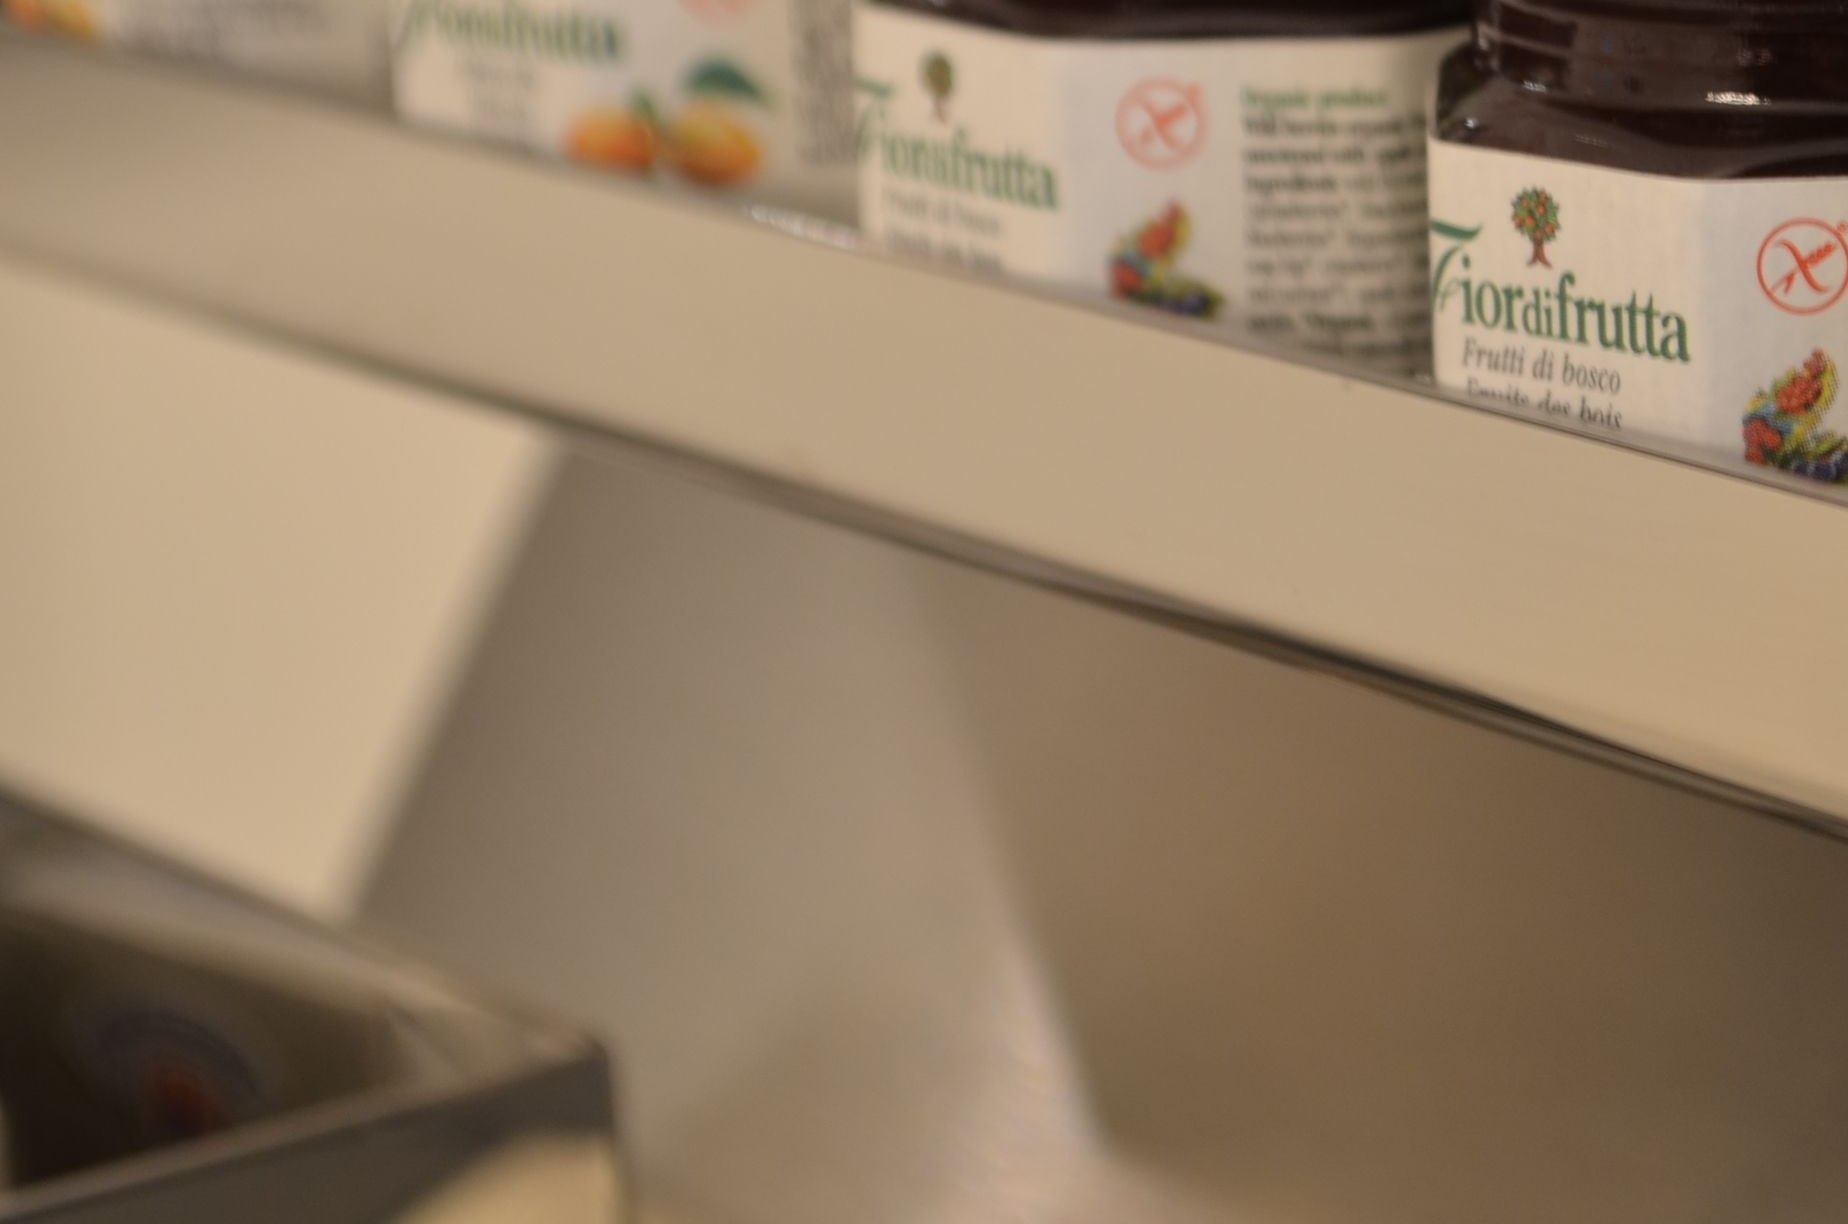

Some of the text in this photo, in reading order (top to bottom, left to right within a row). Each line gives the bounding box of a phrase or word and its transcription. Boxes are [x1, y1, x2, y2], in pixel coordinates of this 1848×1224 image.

[1461, 337, 1525, 375] Frutti
[1532, 348, 1553, 380] di
[1562, 352, 1622, 396] bosco
